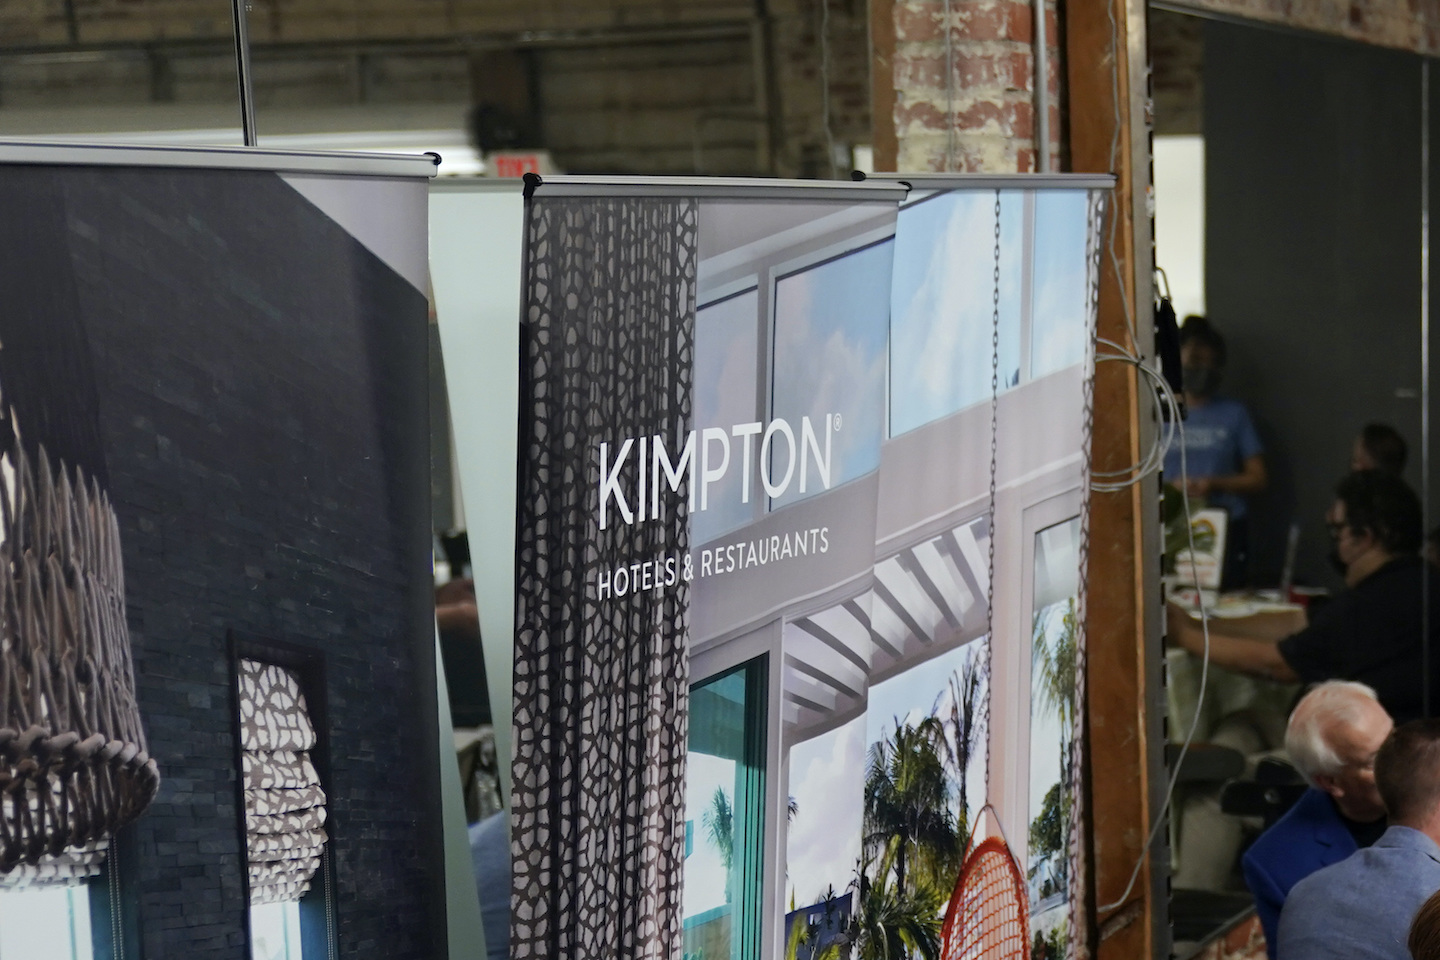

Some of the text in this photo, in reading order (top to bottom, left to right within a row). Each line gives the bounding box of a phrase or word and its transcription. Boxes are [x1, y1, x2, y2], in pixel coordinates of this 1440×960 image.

[599, 413, 832, 531] KIMPTON
[598, 527, 829, 600] HOTELS & RESTAURANTS
